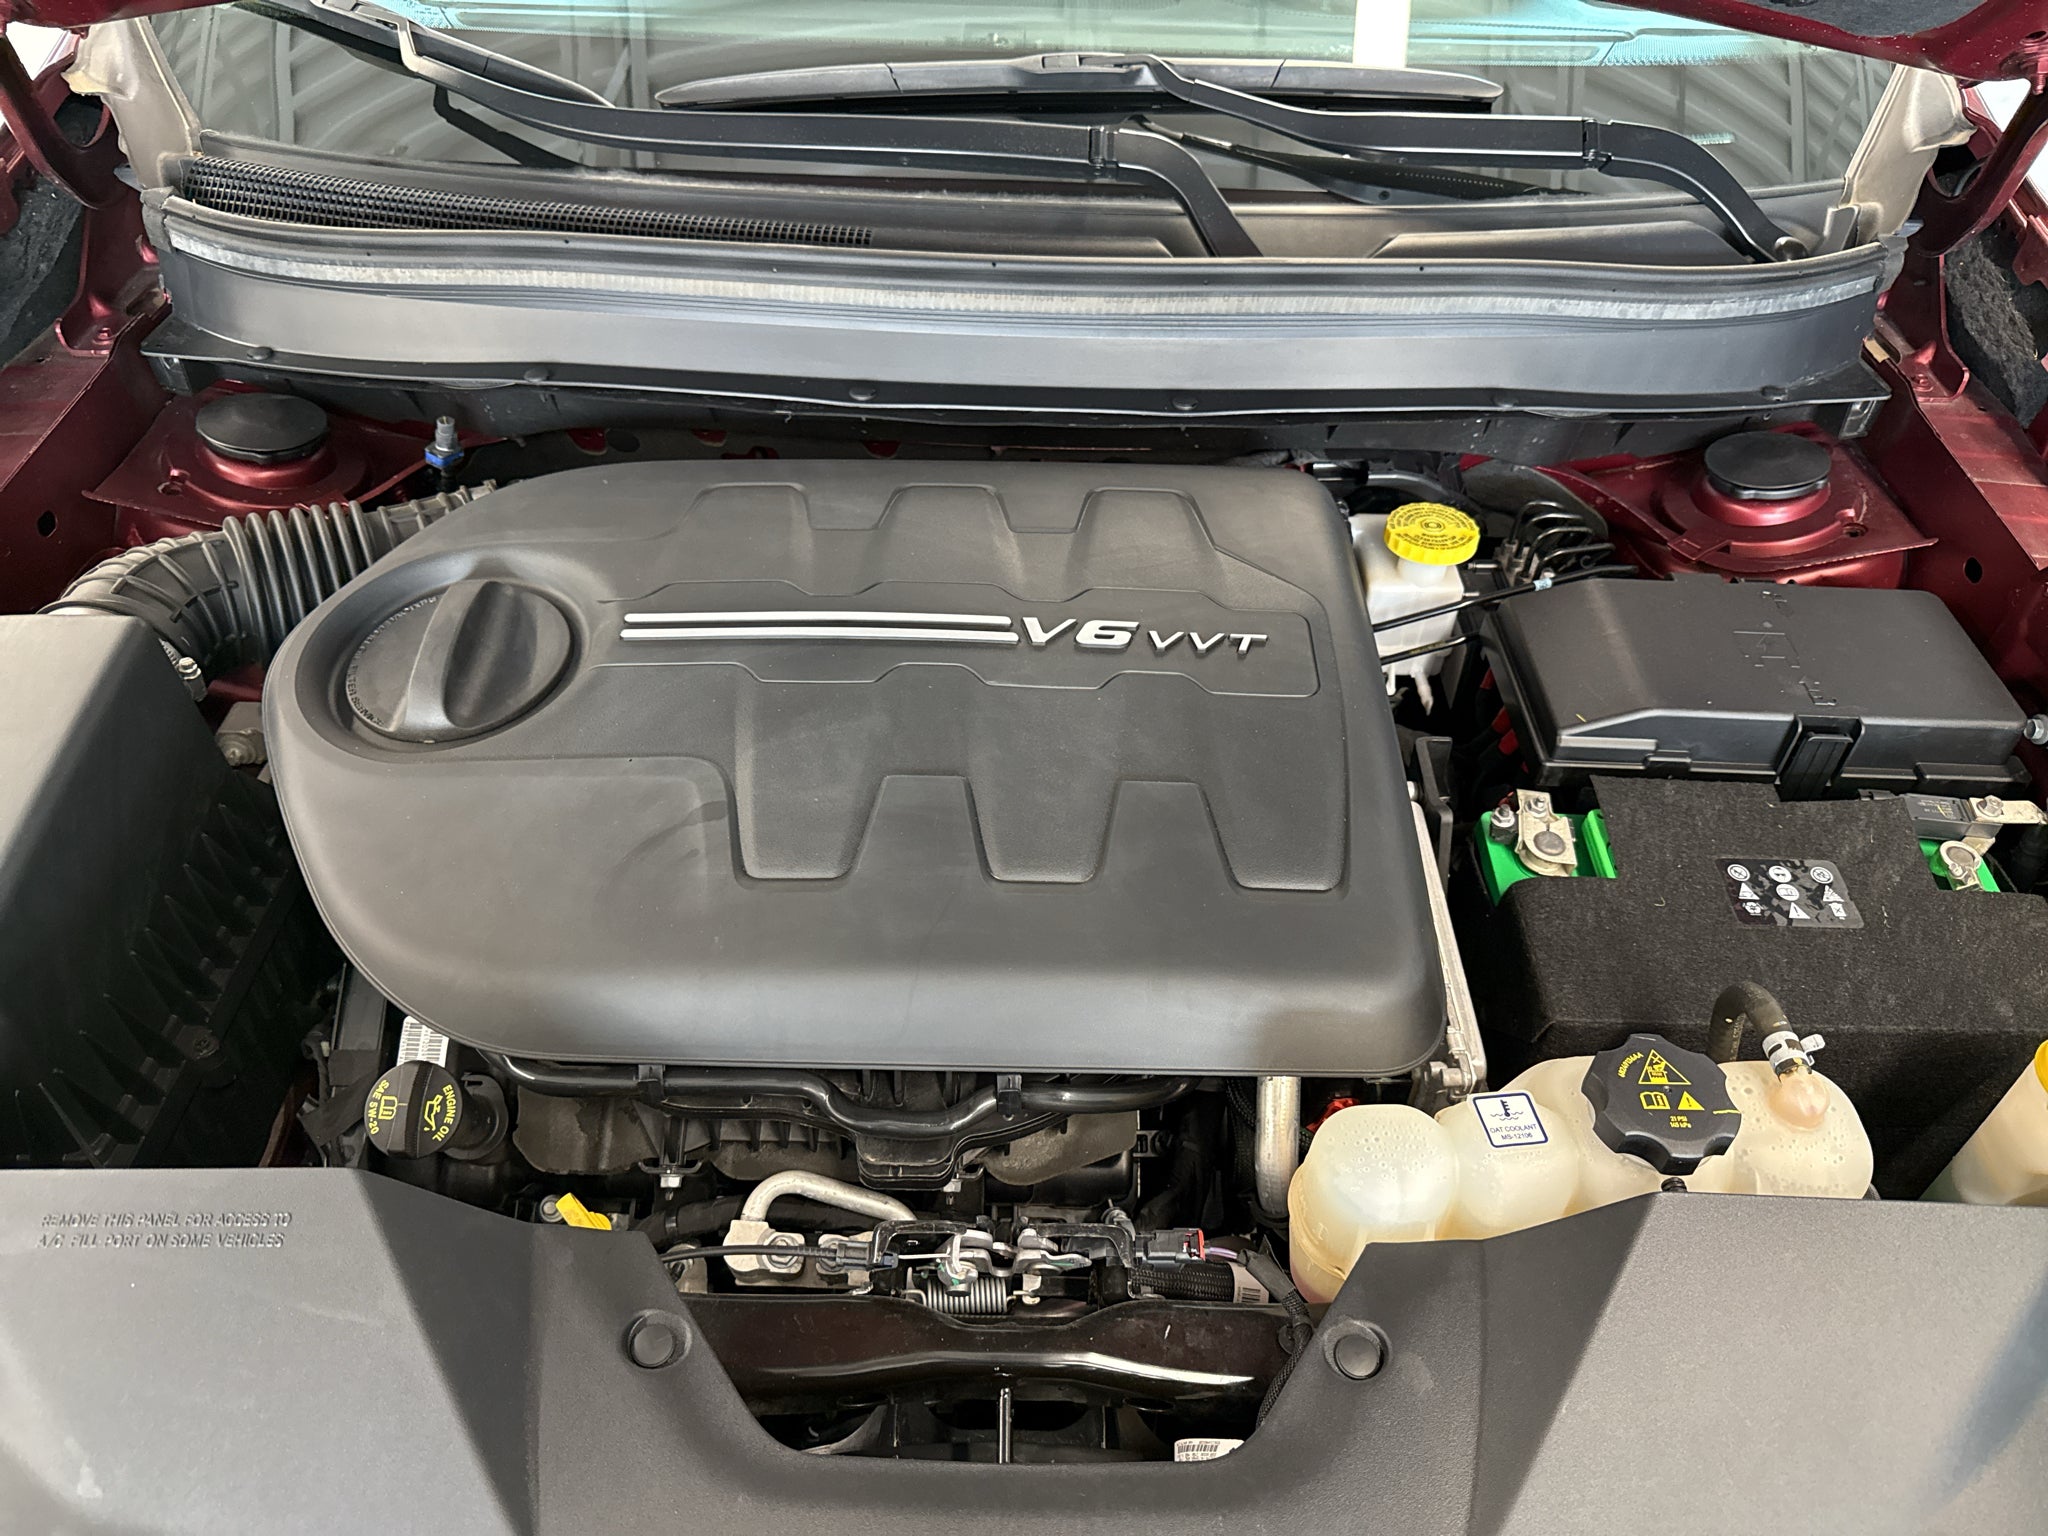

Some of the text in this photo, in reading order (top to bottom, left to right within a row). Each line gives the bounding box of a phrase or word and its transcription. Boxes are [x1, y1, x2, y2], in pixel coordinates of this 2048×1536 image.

[1022, 617, 1268, 654] V6 VVT
[367, 1079, 390, 1135] SAE 5W-20
[432, 1084, 457, 1142] ENGINE OIL
[1504, 1123, 1537, 1132] COOLANT
[1500, 1132, 1533, 1140] MS-12106
[41, 1212, 293, 1228] REMOVE THIS PANEL FOR ACCESS TO
[104, 1232, 141, 1248] PORT
[146, 1232, 169, 1248] ON
[170, 1232, 212, 1248] SOME
[217, 1232, 285, 1248] VEHICLES
